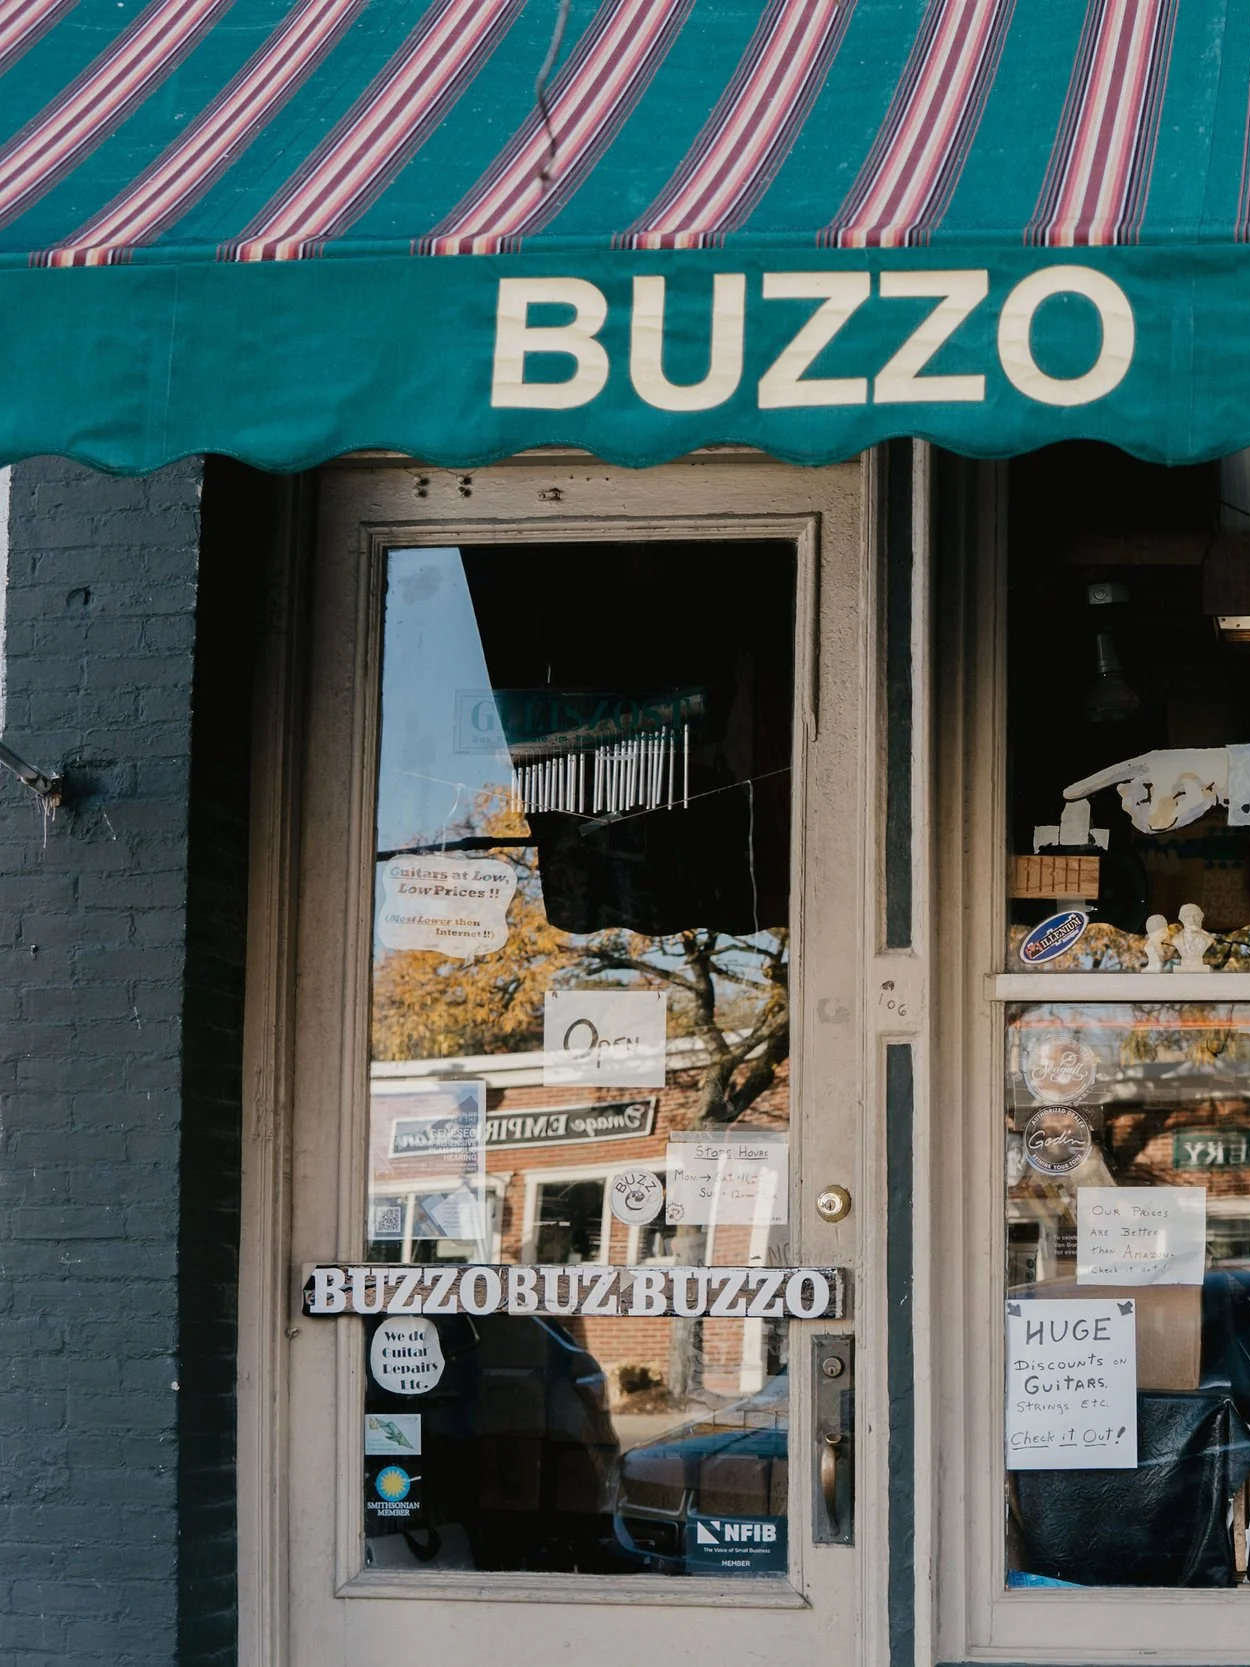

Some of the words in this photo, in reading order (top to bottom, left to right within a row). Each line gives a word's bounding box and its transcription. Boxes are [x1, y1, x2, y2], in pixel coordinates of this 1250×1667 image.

[490, 264, 1136, 411] BUZZO
[389, 866, 448, 881] Guitars
[451, 871, 469, 881] at
[471, 870, 510, 885] Low,
[397, 883, 432, 896] Low
[433, 885, 486, 898] Prices
[1031, 1108, 1066, 1125] AUTHORIZED
[1066, 1109, 1086, 1129] DEALER
[1028, 1130, 1086, 1149] Godin
[615, 1173, 657, 1194] BUZZ
[309, 1265, 501, 1316] BUZZO
[508, 1267, 621, 1315] BUZ
[628, 1269, 830, 1319] BUZZO
[384, 1331, 405, 1341] We
[408, 1330, 426, 1341] do
[1025, 1316, 1112, 1346] HUGE
[382, 1347, 430, 1358] Guitar
[383, 1362, 439, 1375] Repairs
[400, 1379, 429, 1390] Etc.
[1061, 1428, 1075, 1443] it
[724, 1523, 777, 1542] NFIB
